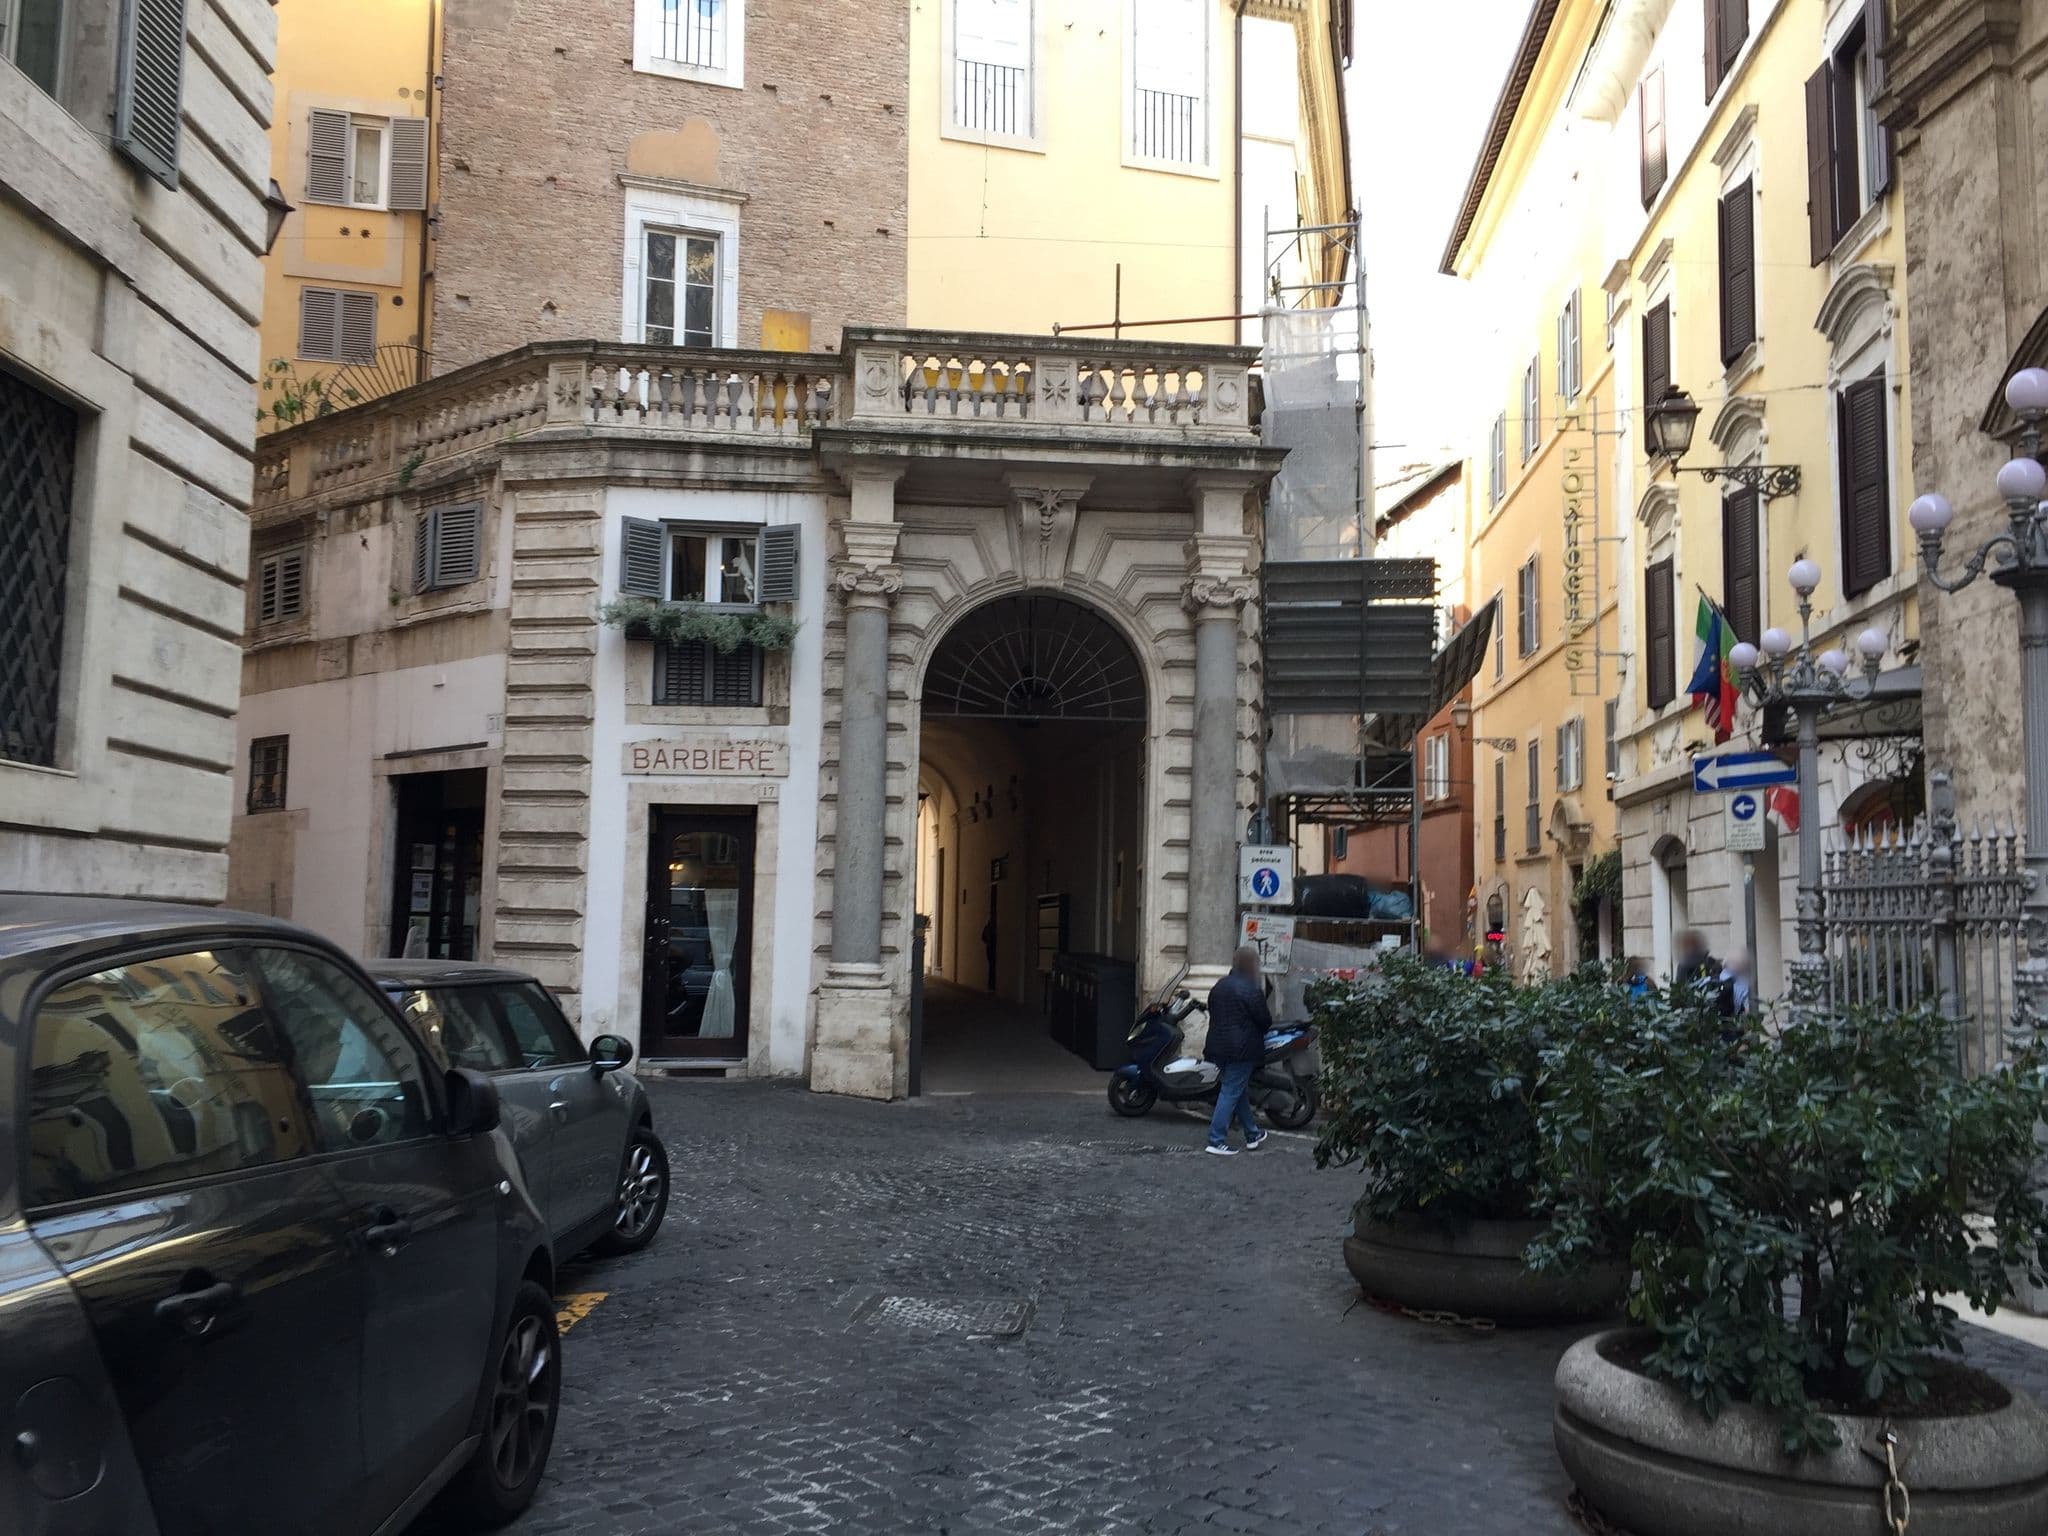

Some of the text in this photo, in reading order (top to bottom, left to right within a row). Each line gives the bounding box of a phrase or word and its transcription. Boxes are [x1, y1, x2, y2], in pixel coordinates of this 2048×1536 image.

[1562, 447, 1584, 696] PORTOGHESI
[633, 748, 775, 771] BARBIERE
[762, 786, 775, 796] 17
